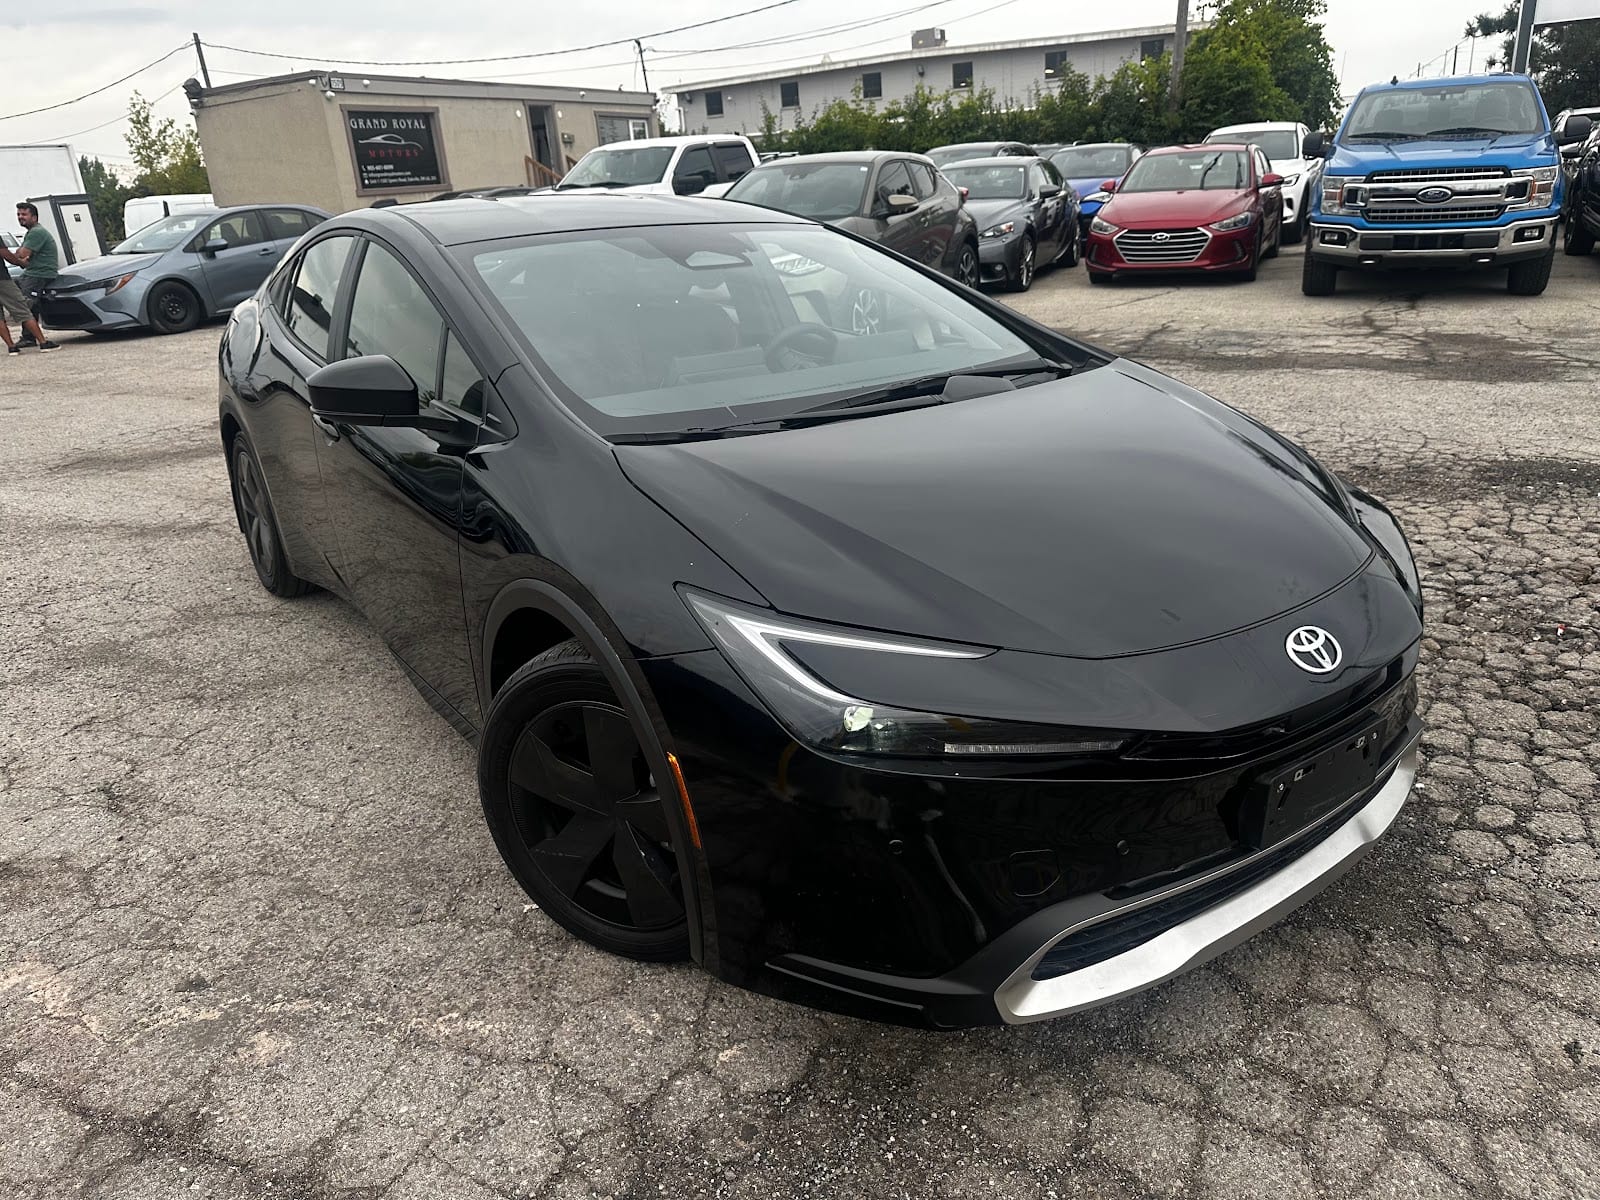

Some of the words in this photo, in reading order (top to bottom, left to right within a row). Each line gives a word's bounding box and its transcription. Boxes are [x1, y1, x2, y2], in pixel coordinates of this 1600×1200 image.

[350, 118, 387, 129] GRAND
[392, 118, 426, 129] ROYAL
[368, 148, 418, 158] MOTORS
